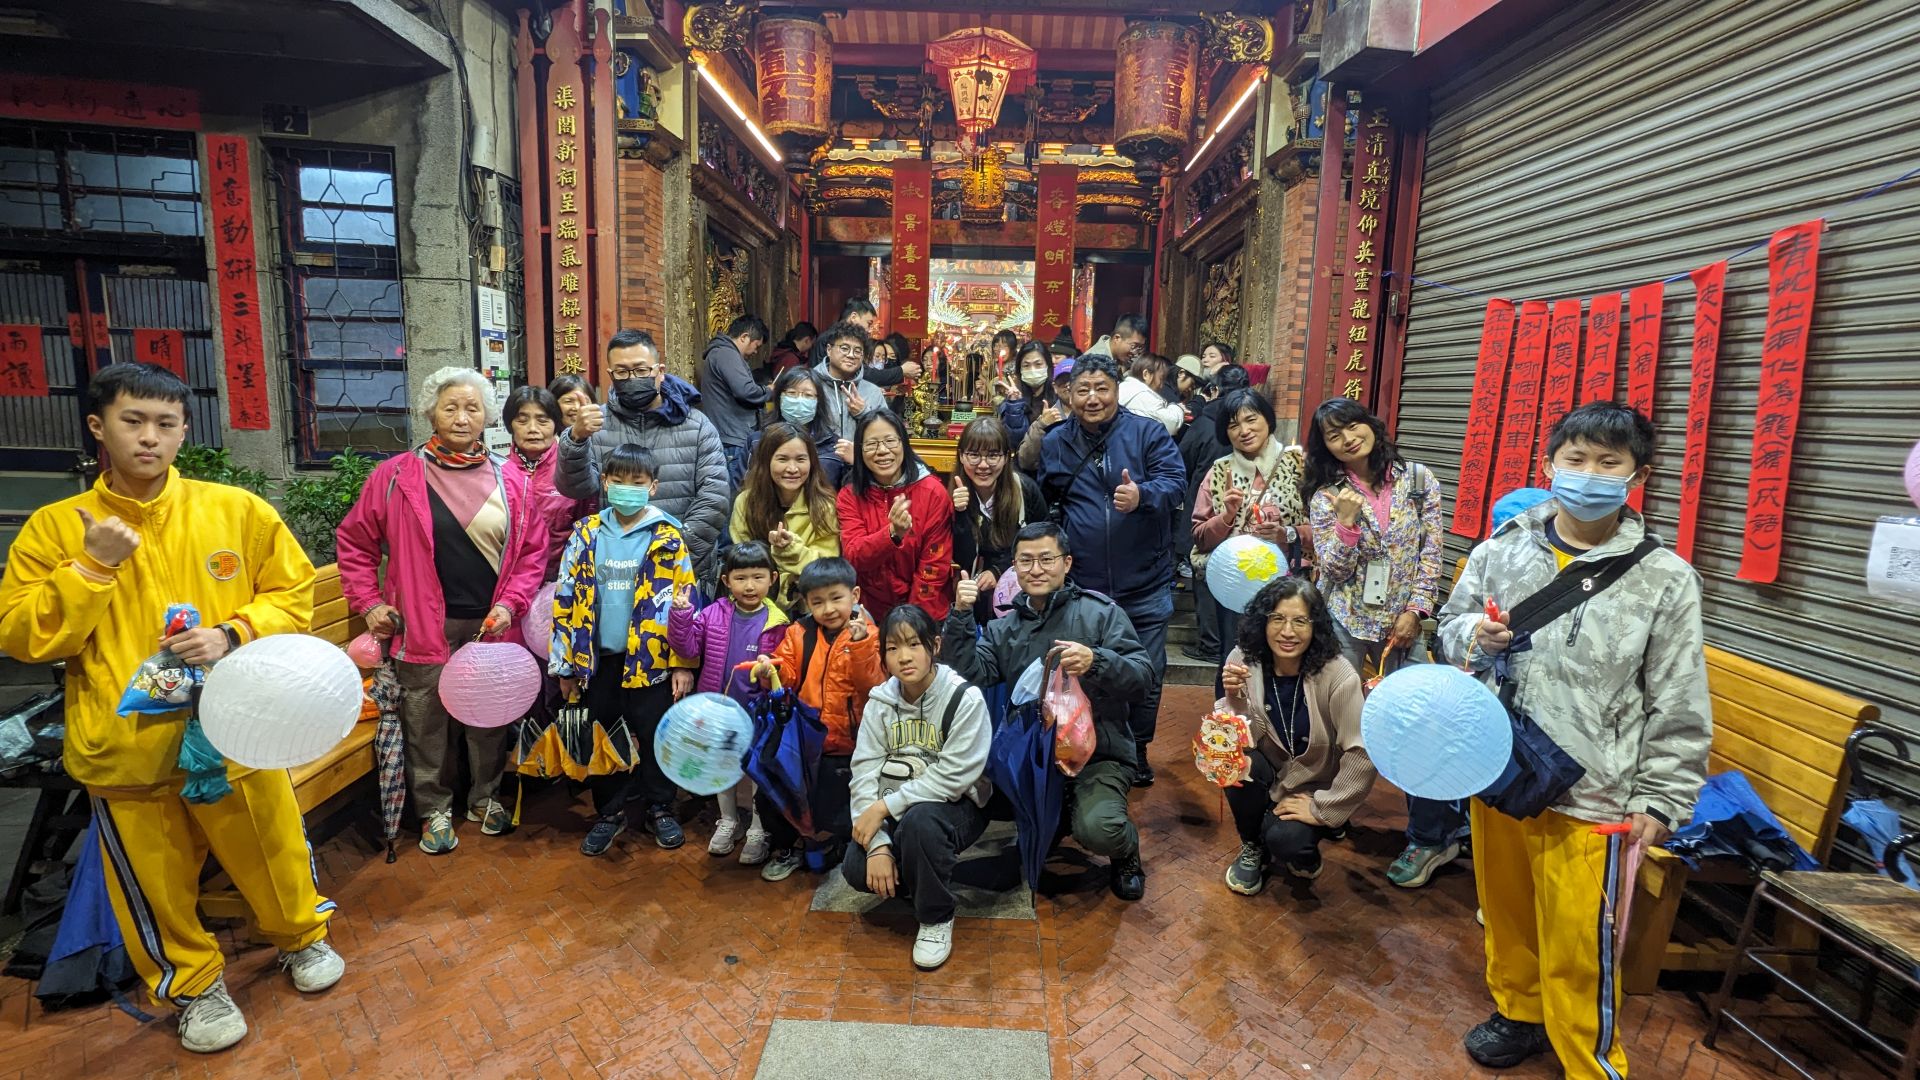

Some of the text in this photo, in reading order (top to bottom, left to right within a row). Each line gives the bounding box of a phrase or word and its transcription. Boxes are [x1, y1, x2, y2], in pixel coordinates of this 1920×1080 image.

[284, 115, 294, 131] 2
[151, 333, 173, 369] 晴
[607, 581, 631, 590] stick
